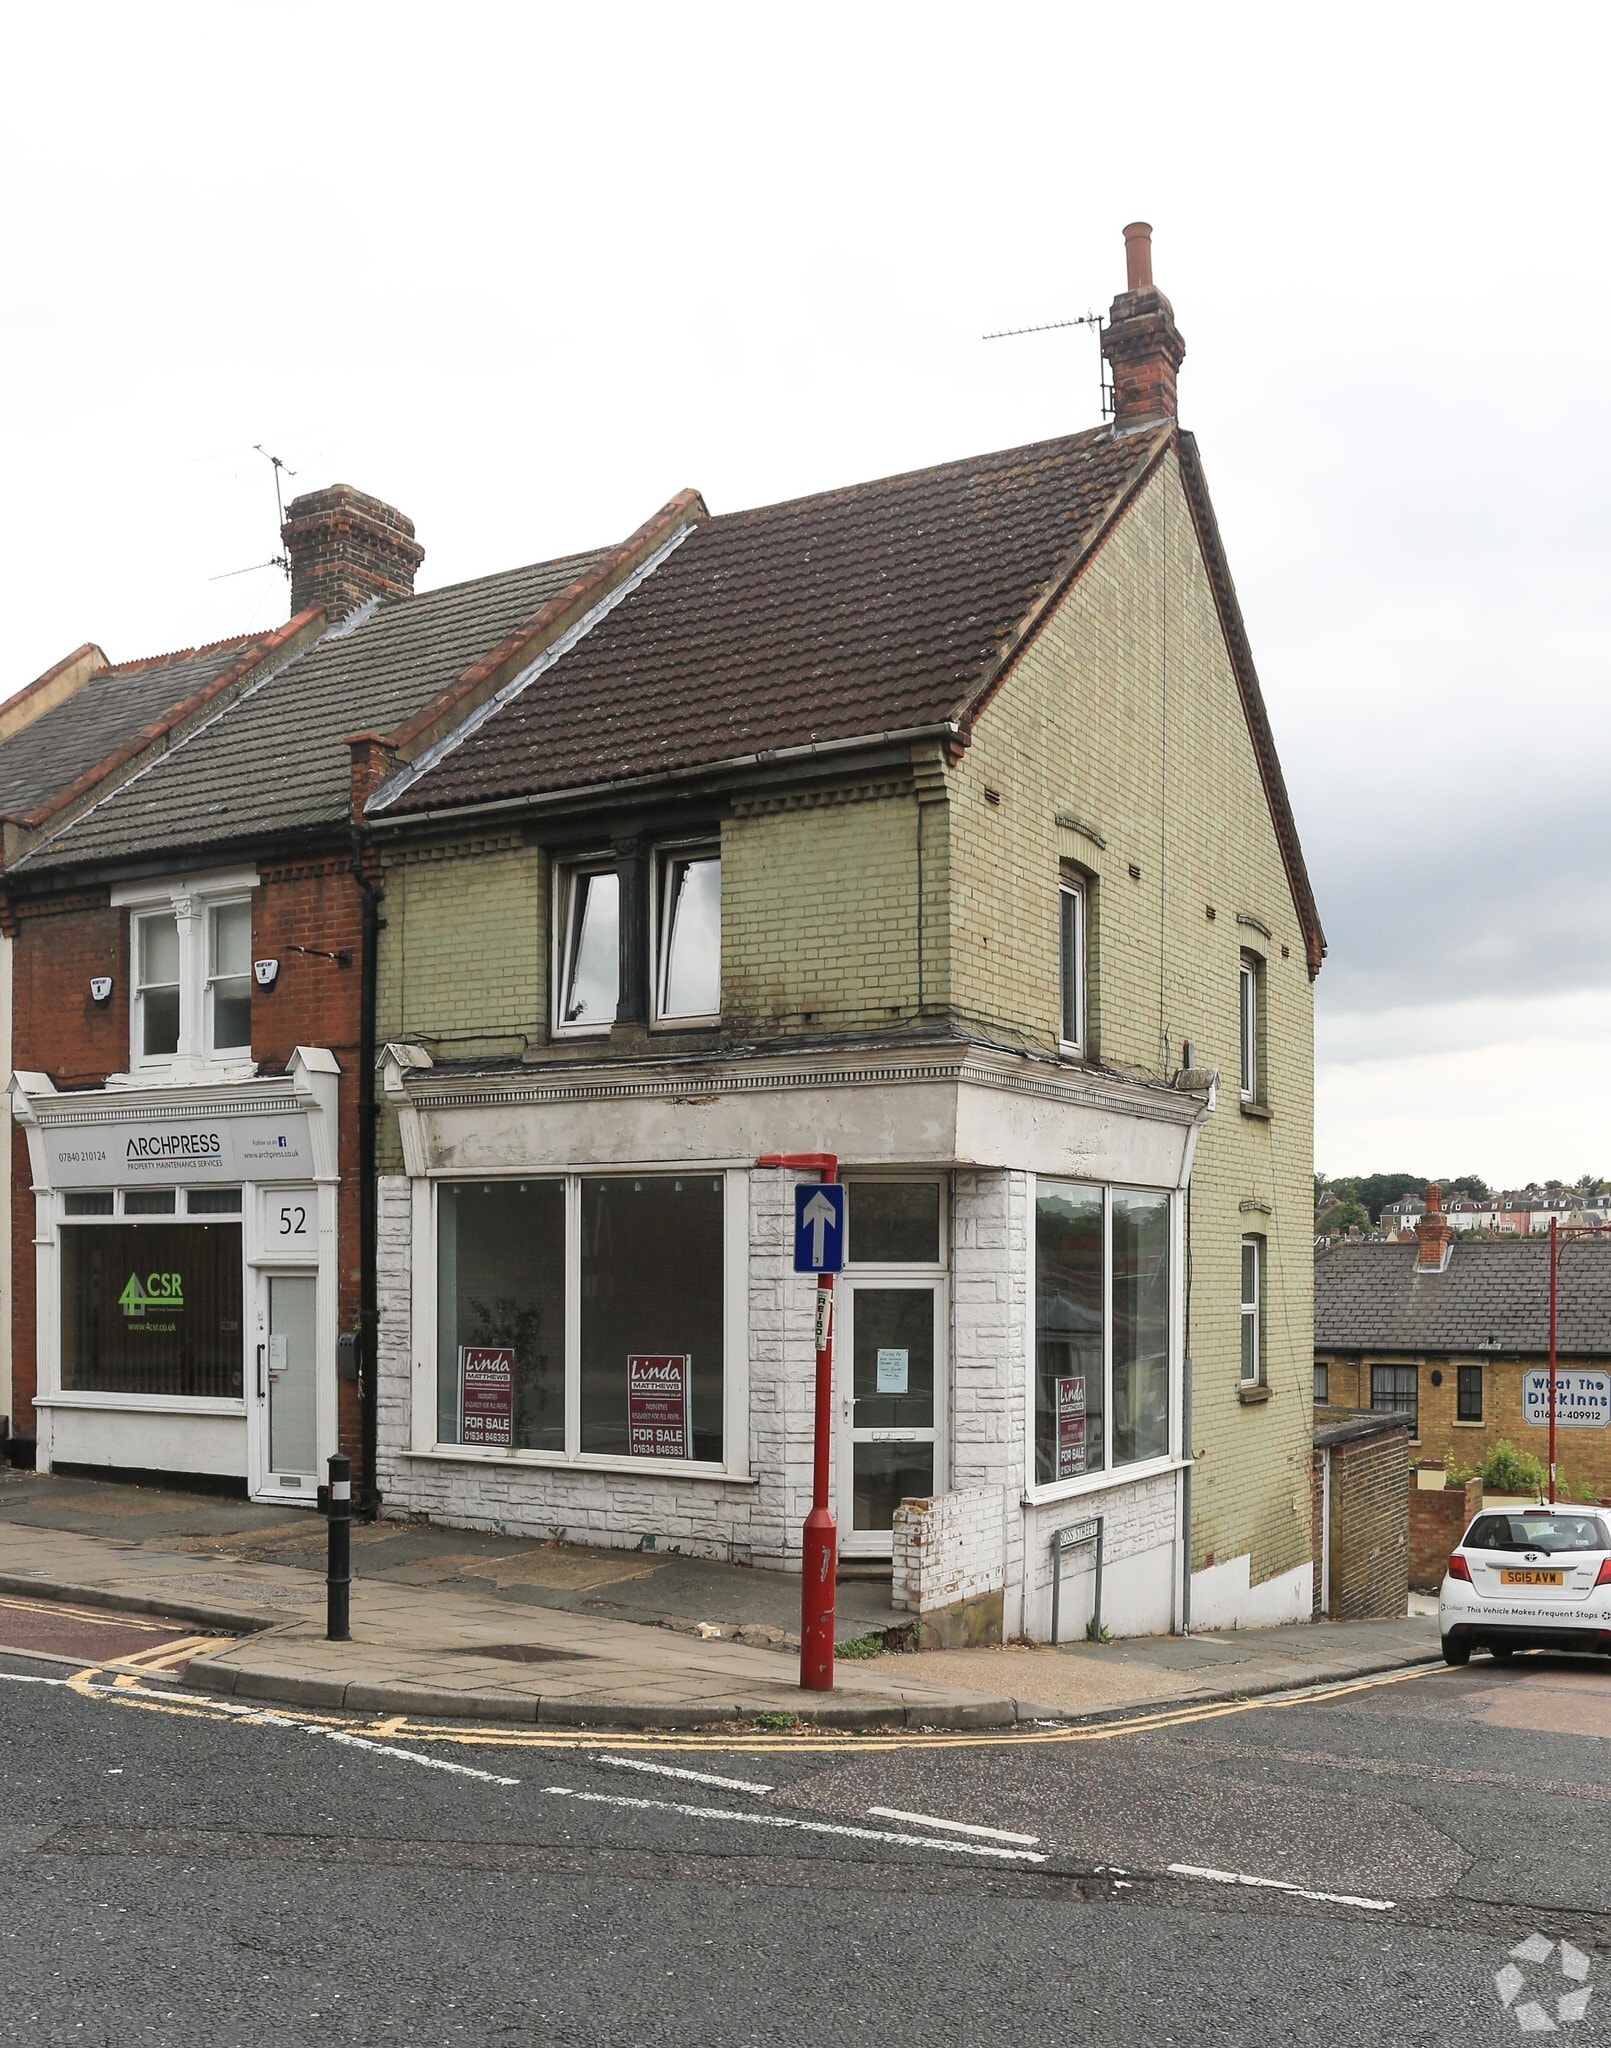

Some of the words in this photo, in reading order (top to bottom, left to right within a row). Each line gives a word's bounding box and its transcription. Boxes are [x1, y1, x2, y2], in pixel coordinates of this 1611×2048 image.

[126, 1133, 220, 1156] ARCHPRESS
[59, 1152, 79, 1162] 07840
[81, 1151, 106, 1161] 210124
[244, 1149, 299, 1159] www.archpress.co.uk
[127, 1162, 155, 1170] PROPERTY
[156, 1161, 197, 1169] MAINTENANCE
[198, 1160, 223, 1168] SERVICES
[280, 1207, 306, 1234] 52
[128, 1322, 177, 1332] www.4csr.co.uk
[466, 1352, 510, 1372] Linda
[631, 1360, 681, 1380] Linda
[632, 1382, 680, 1390] MATTHEWS
[1579, 1379, 1604, 1390] The
[1060, 1381, 1084, 1403] Linda
[1534, 1410, 1601, 1420] 0164-409912
[465, 1416, 483, 1428] FOR
[485, 1418, 510, 1430] SALE
[464, 1431, 484, 1441] 01634
[633, 1429, 653, 1441] FOR
[656, 1429, 682, 1442] SALE
[633, 1444, 654, 1454] 01634
[1061, 1449, 1071, 1462] FOR
[1072, 1447, 1084, 1460] SALE
[1076, 1521, 1096, 1540] STREET
[1508, 1572, 1532, 1583] SG15
[1535, 1572, 1556, 1584] AVW
[1467, 1605, 1481, 1613] This
[1483, 1606, 1510, 1615] Vehicle
[1511, 1608, 1536, 1616] Makes
[1538, 1609, 1573, 1619] Frequent
[1576, 1610, 1598, 1620] Stops
